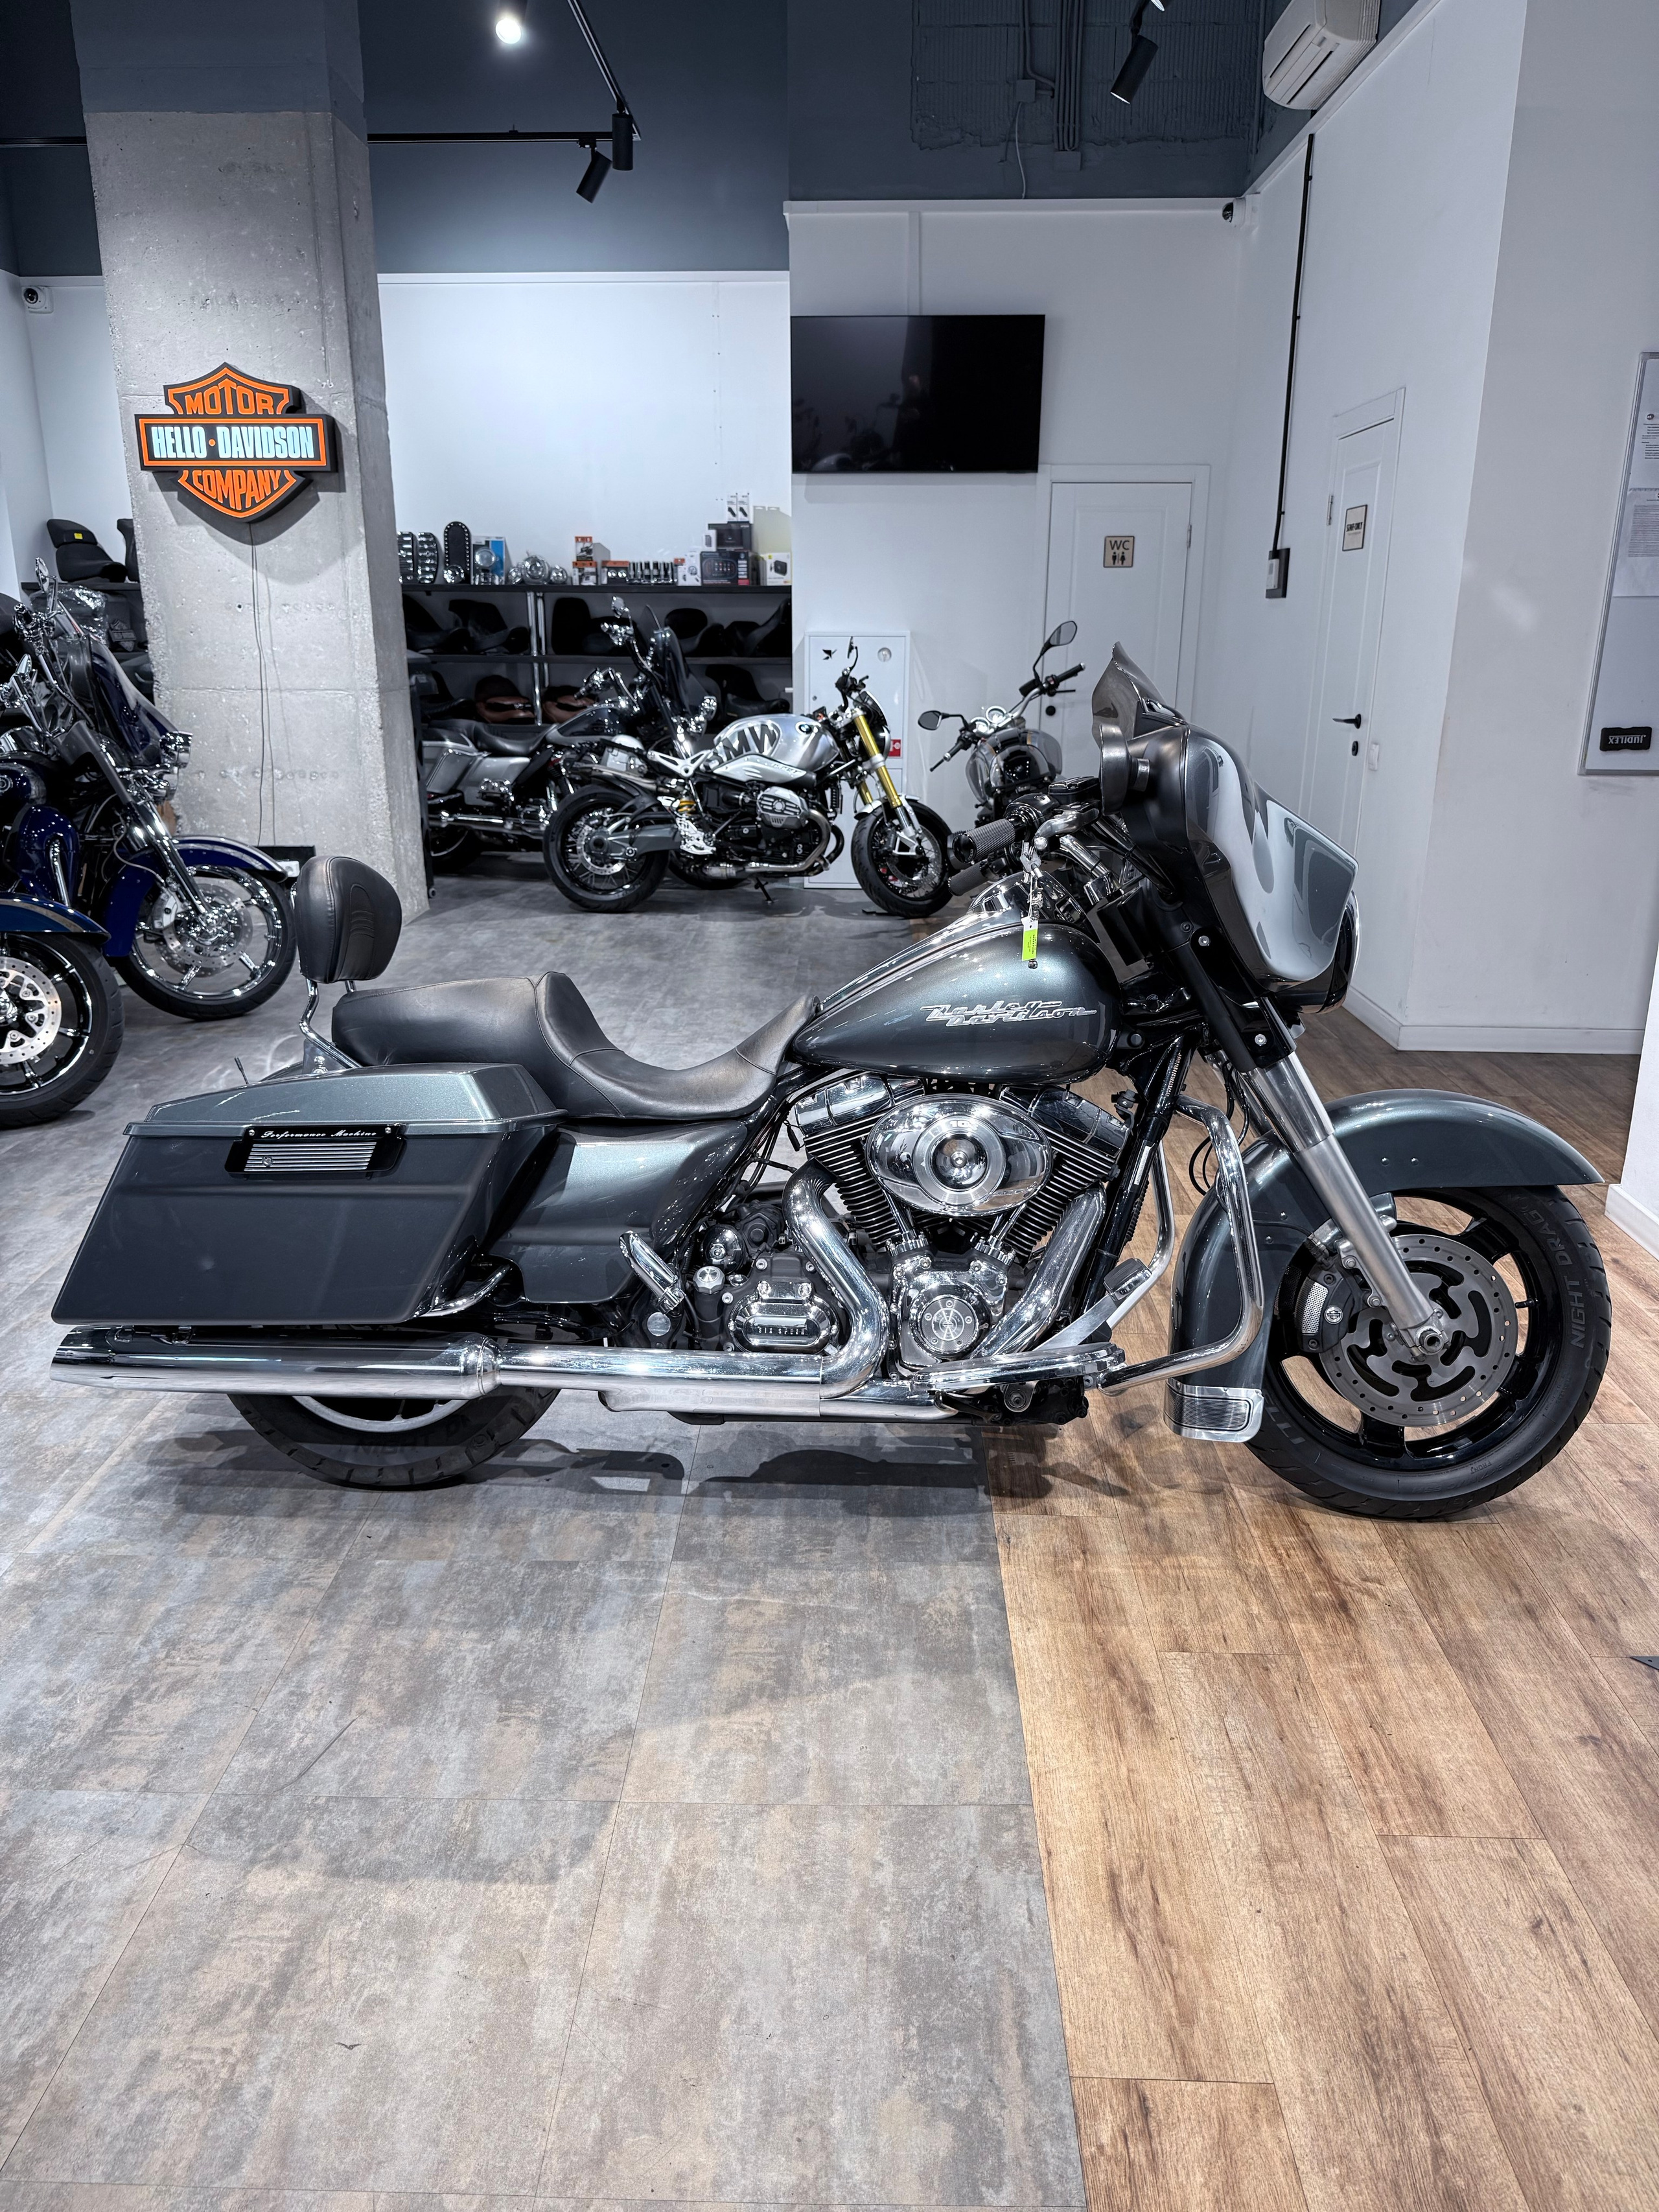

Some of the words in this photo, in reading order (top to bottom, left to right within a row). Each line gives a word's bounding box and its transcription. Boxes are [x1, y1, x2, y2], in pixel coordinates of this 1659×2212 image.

[185, 378, 274, 415] MOTOR
[151, 426, 207, 459] HELLO
[216, 426, 314, 459] DAVIDSON
[192, 469, 281, 511] COMPANY
[1109, 540, 1130, 550] WC
[261, 1130, 326, 1139] Performance
[1563, 1275, 1586, 1348] NIGHT
[1470, 1460, 1492, 1474] FRONT
